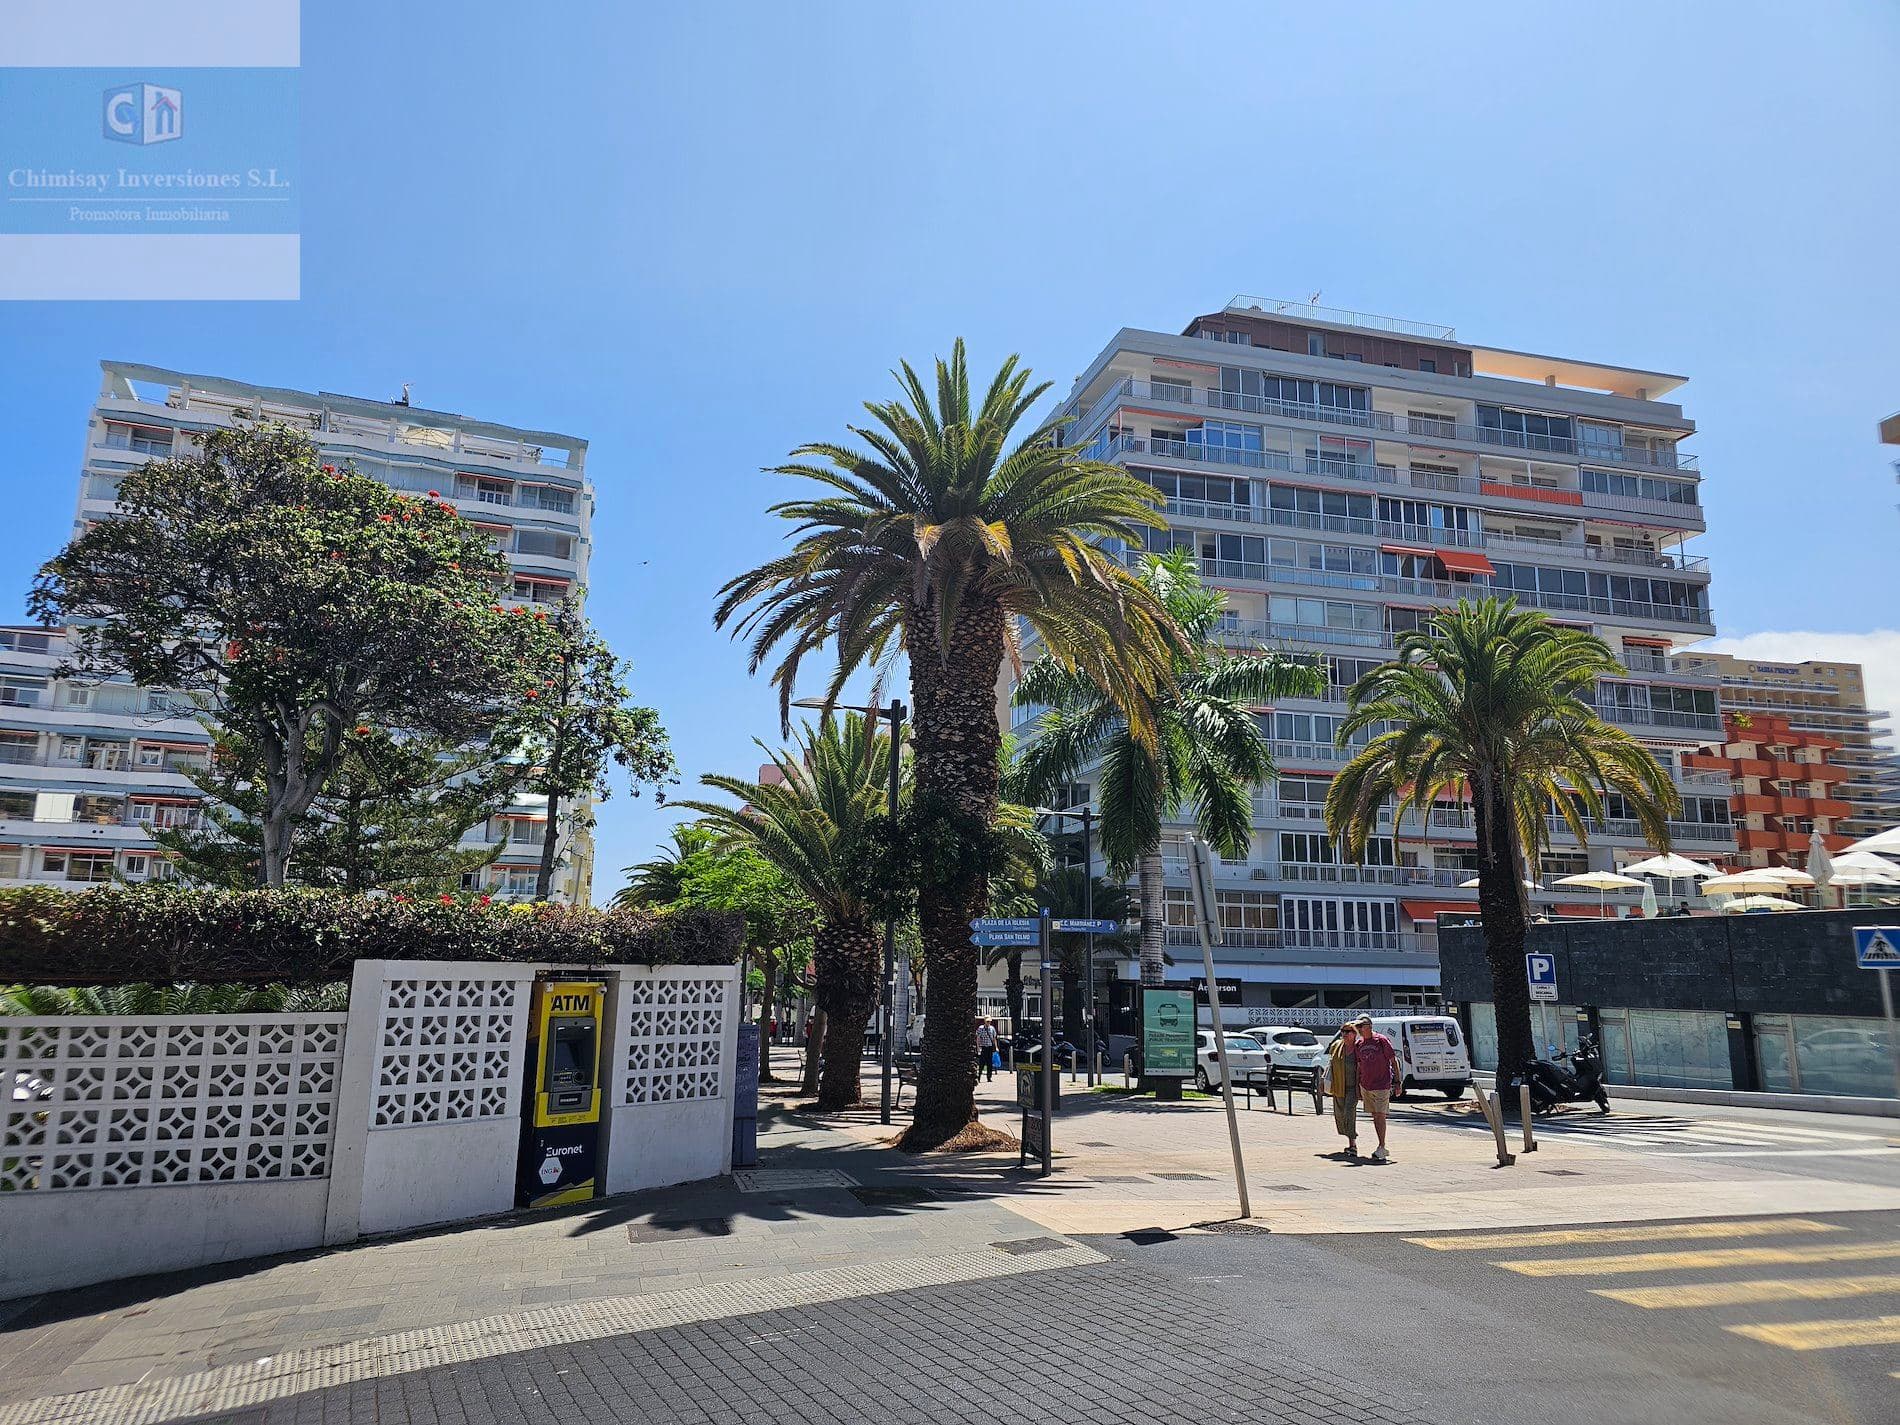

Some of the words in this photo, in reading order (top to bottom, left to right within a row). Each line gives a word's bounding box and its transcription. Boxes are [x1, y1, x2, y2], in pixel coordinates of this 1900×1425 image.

[1532, 958, 1549, 980] P
[1197, 981, 1237, 994] Aperson
[551, 995, 590, 1011] ATM
[546, 1144, 583, 1157] Euronet
